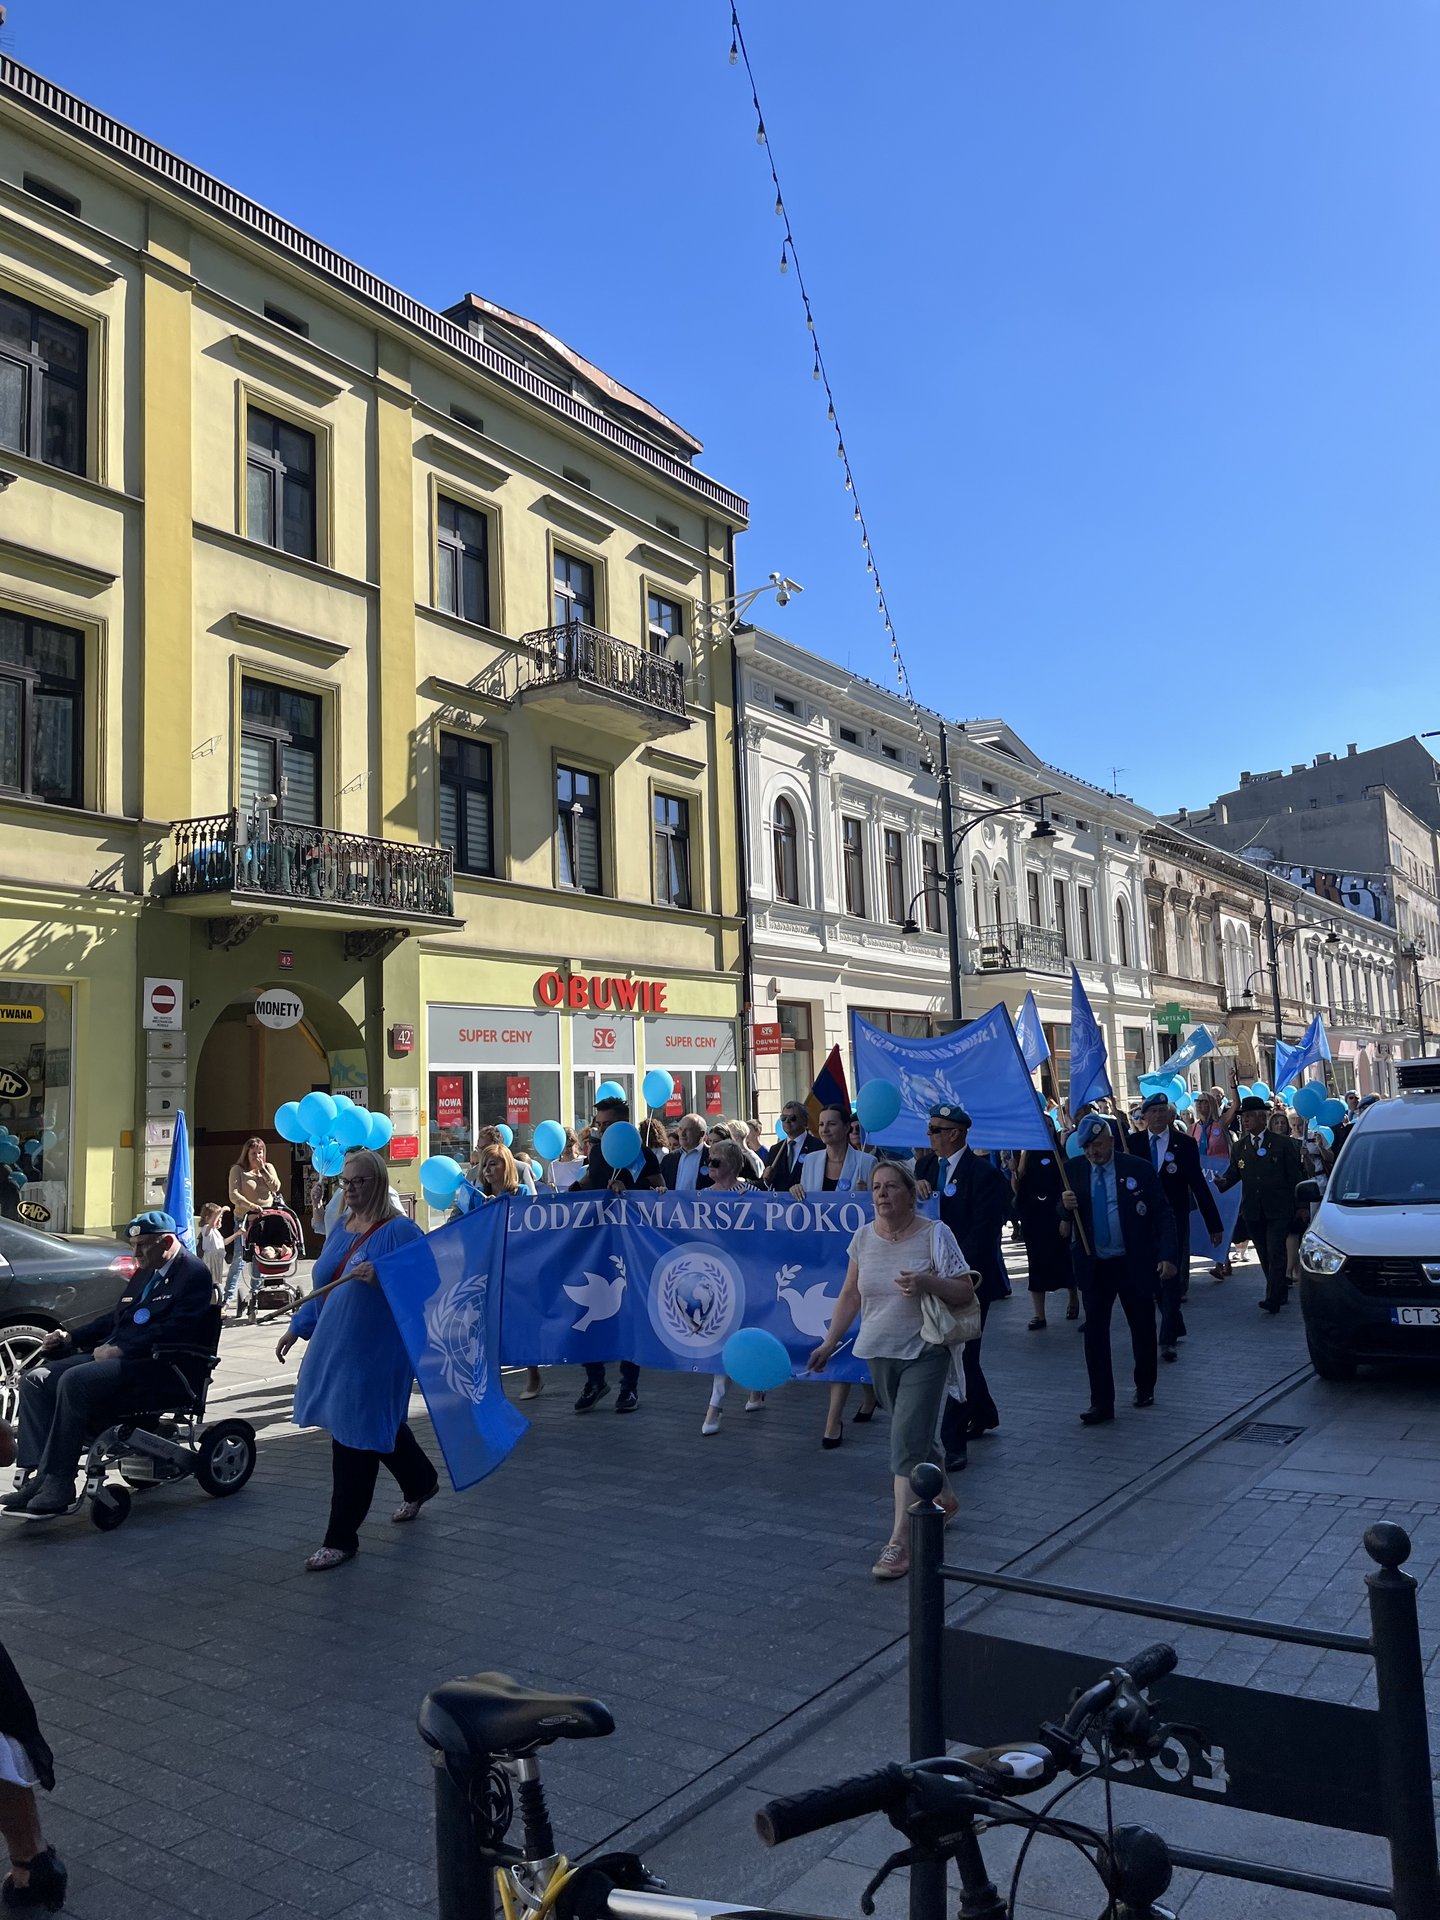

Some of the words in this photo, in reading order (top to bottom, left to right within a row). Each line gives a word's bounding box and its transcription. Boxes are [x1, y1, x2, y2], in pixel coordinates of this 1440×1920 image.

[281, 956, 291, 965] 42
[537, 971, 668, 1014] OBUWIE
[0, 1008, 32, 1020] YWANA
[256, 1000, 300, 1017] MONETY
[397, 1030, 411, 1045] 42
[458, 1028, 498, 1043] SUPER
[501, 1029, 533, 1044] CENY
[592, 1029, 616, 1048] SC
[665, 1035, 693, 1048] SUPER
[694, 1036, 717, 1049] CENY
[439, 1098, 462, 1107] NOWA
[508, 1097, 529, 1106] NOWA
[21, 1203, 49, 1221] FART
[507, 1196, 629, 1233] ŁÓDZKI
[636, 1200, 755, 1231] MARSZ
[764, 1202, 877, 1233] POKO
[1401, 1308, 1423, 1324] CT
